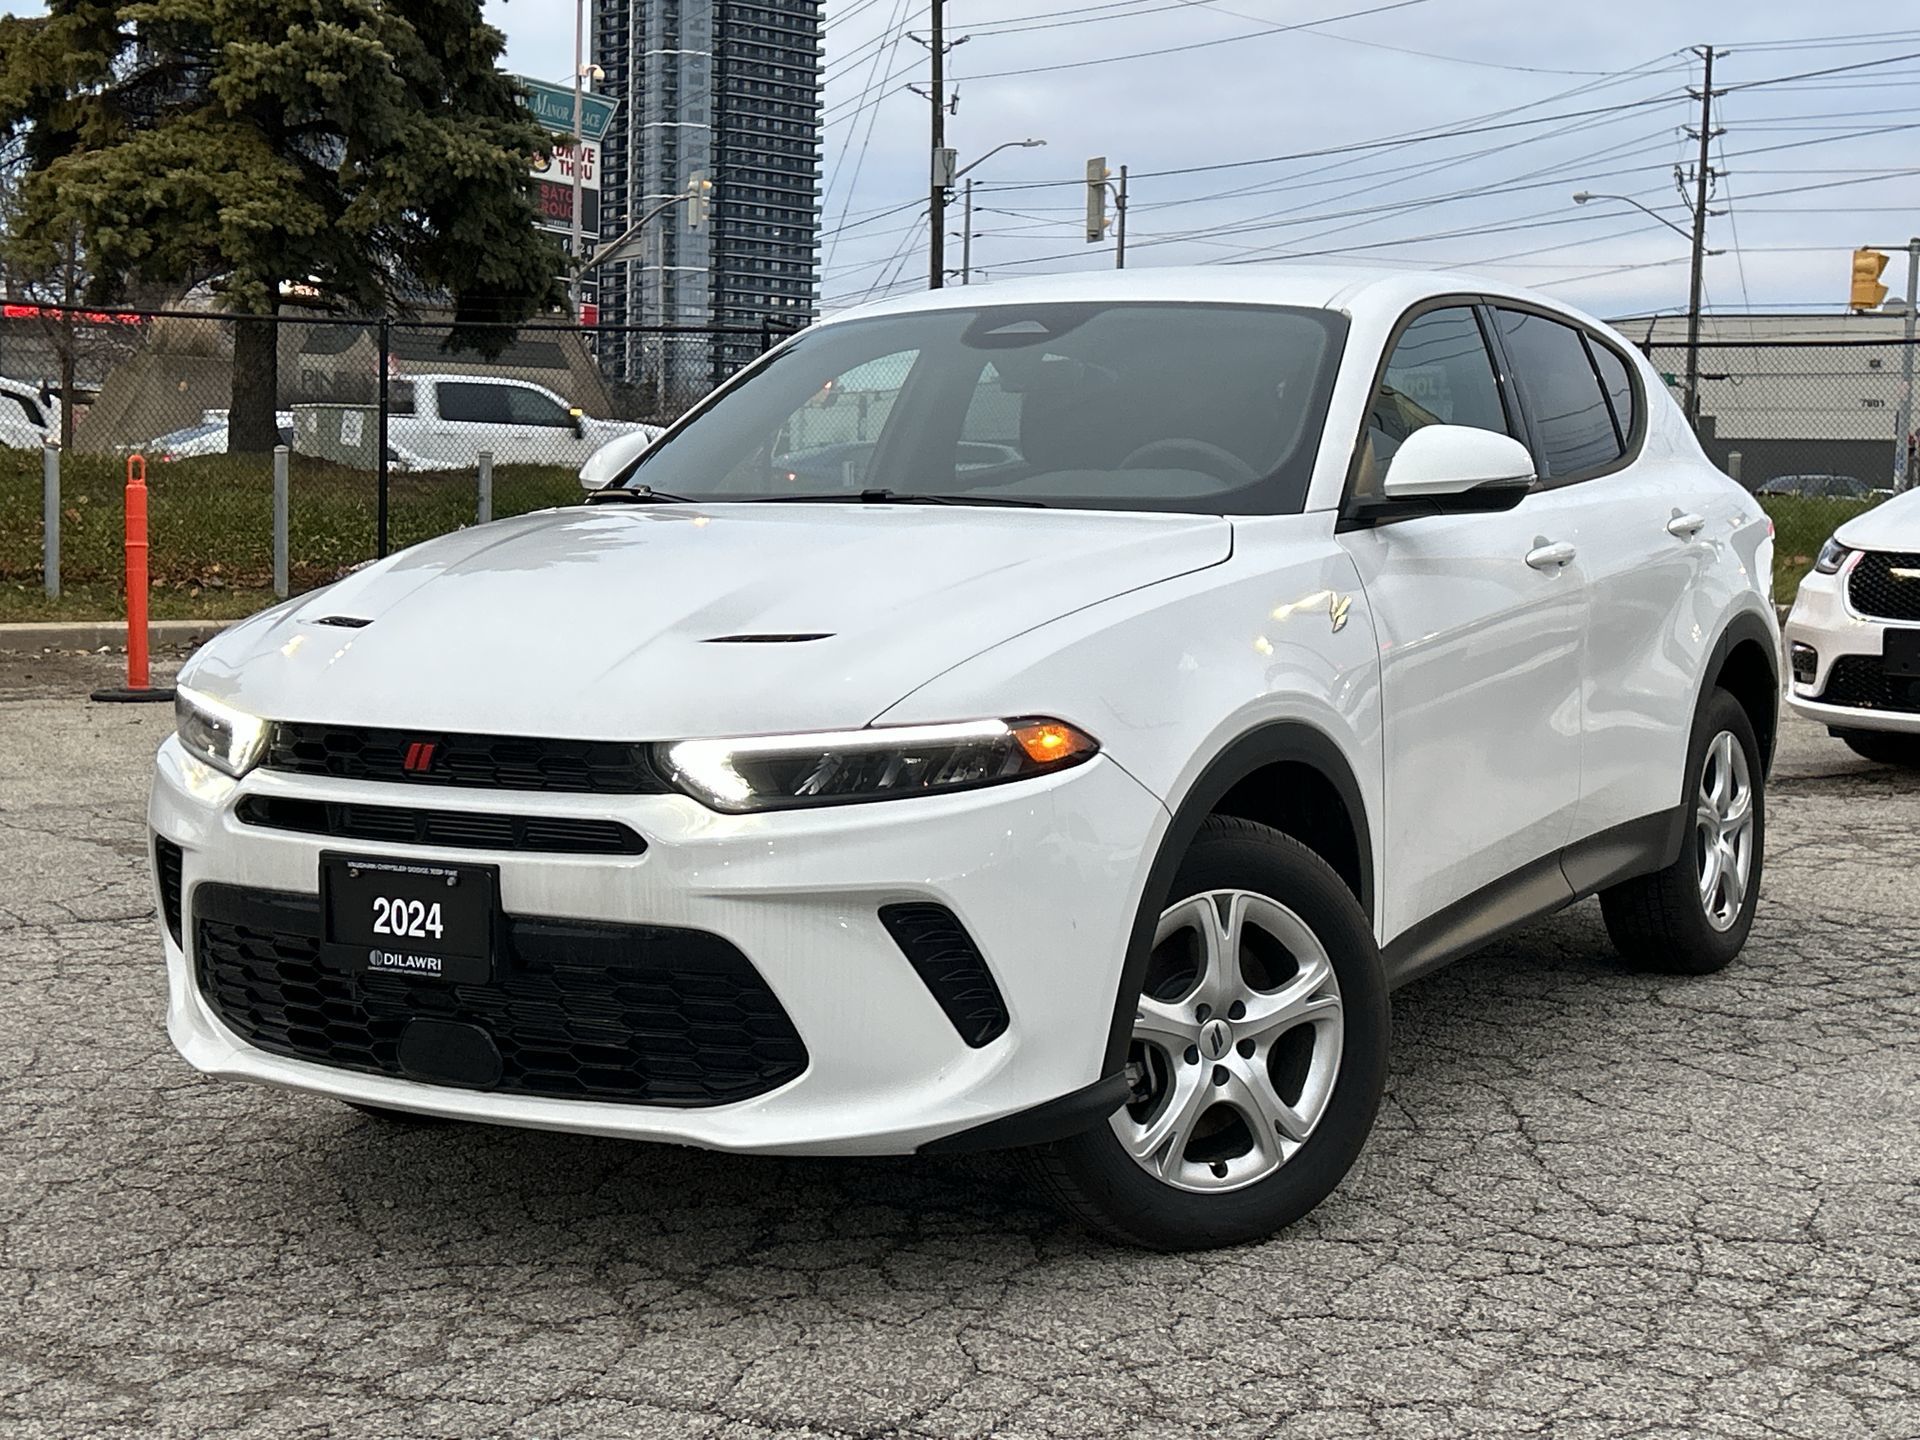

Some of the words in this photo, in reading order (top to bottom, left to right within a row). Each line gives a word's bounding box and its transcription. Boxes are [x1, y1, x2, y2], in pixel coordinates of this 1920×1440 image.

[534, 93, 569, 121] MANOR
[557, 144, 596, 164] DRVE
[540, 183, 574, 203] BATO
[373, 896, 444, 940] 2024
[384, 952, 442, 971] DILAWRI
